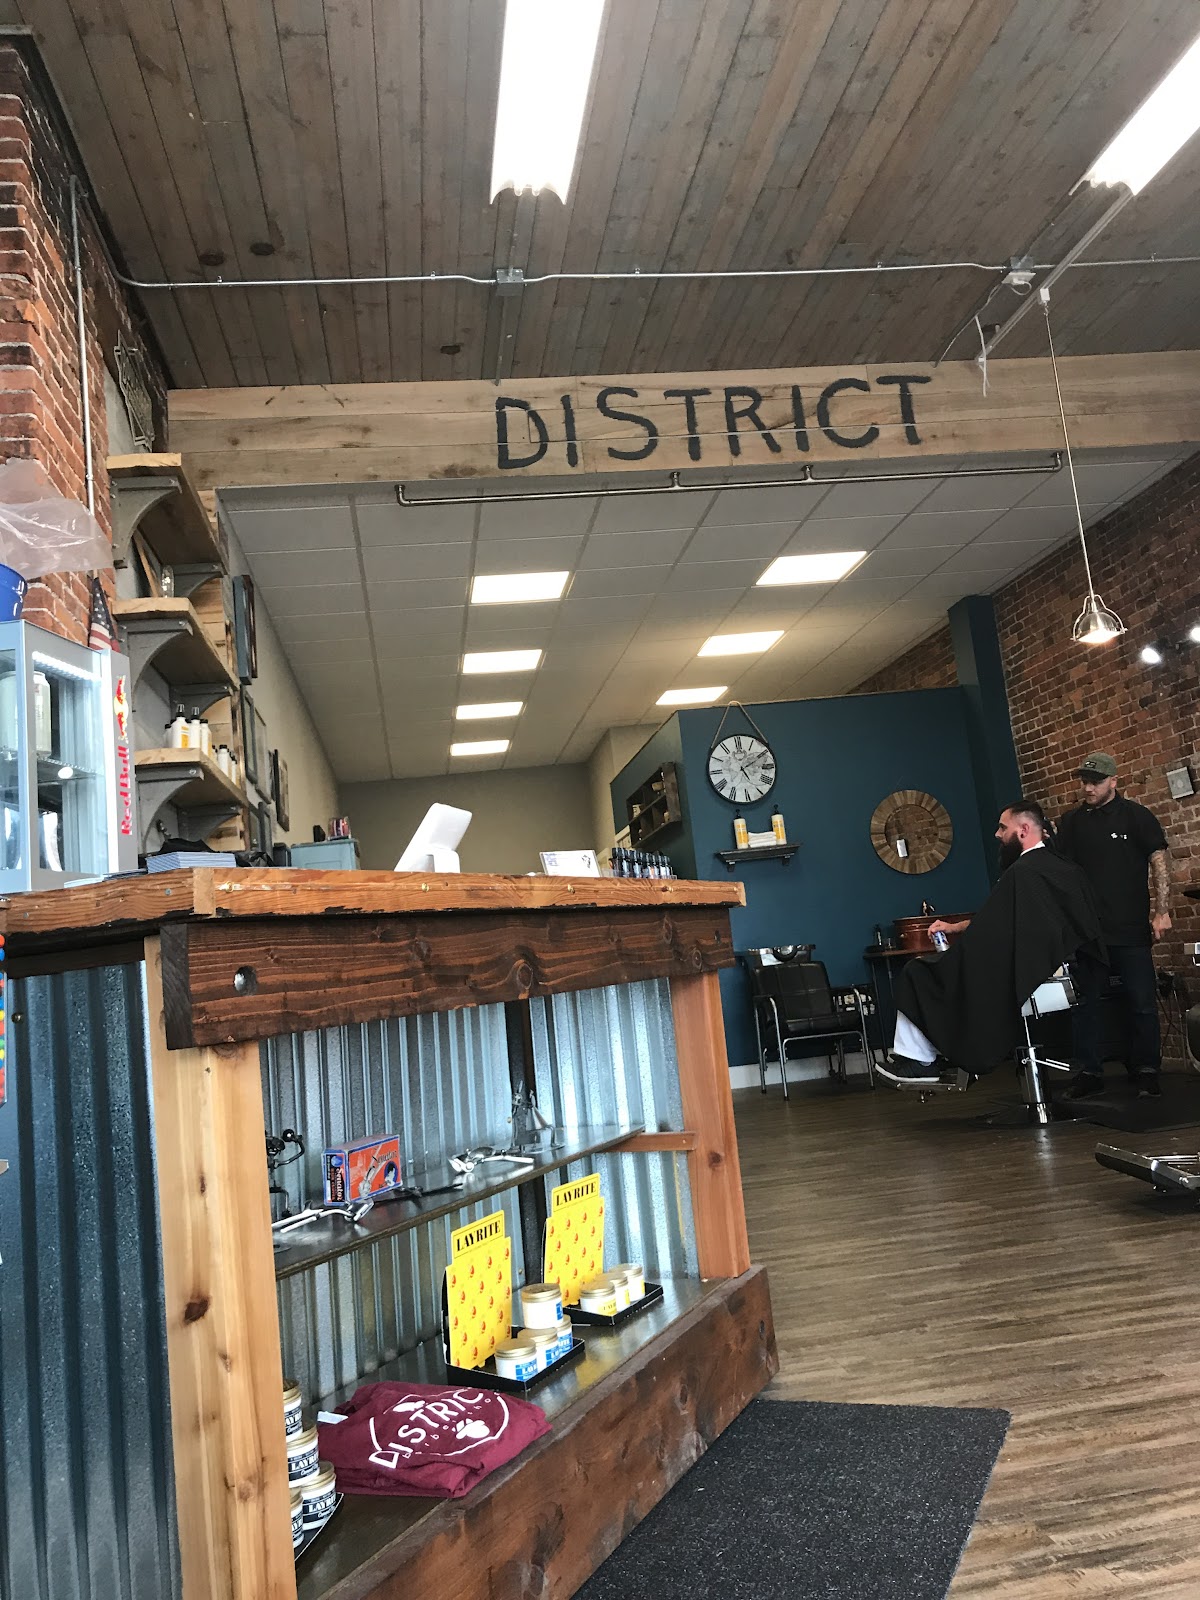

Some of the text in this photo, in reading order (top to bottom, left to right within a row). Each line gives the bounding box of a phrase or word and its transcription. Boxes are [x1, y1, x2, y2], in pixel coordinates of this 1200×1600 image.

[496, 375, 931, 469] DISTRICT
[117, 745, 132, 836] Red Bull
[336, 1168, 344, 1201] Senator
[556, 1181, 597, 1207] LAYRITE
[456, 1220, 501, 1252] LAYRITE
